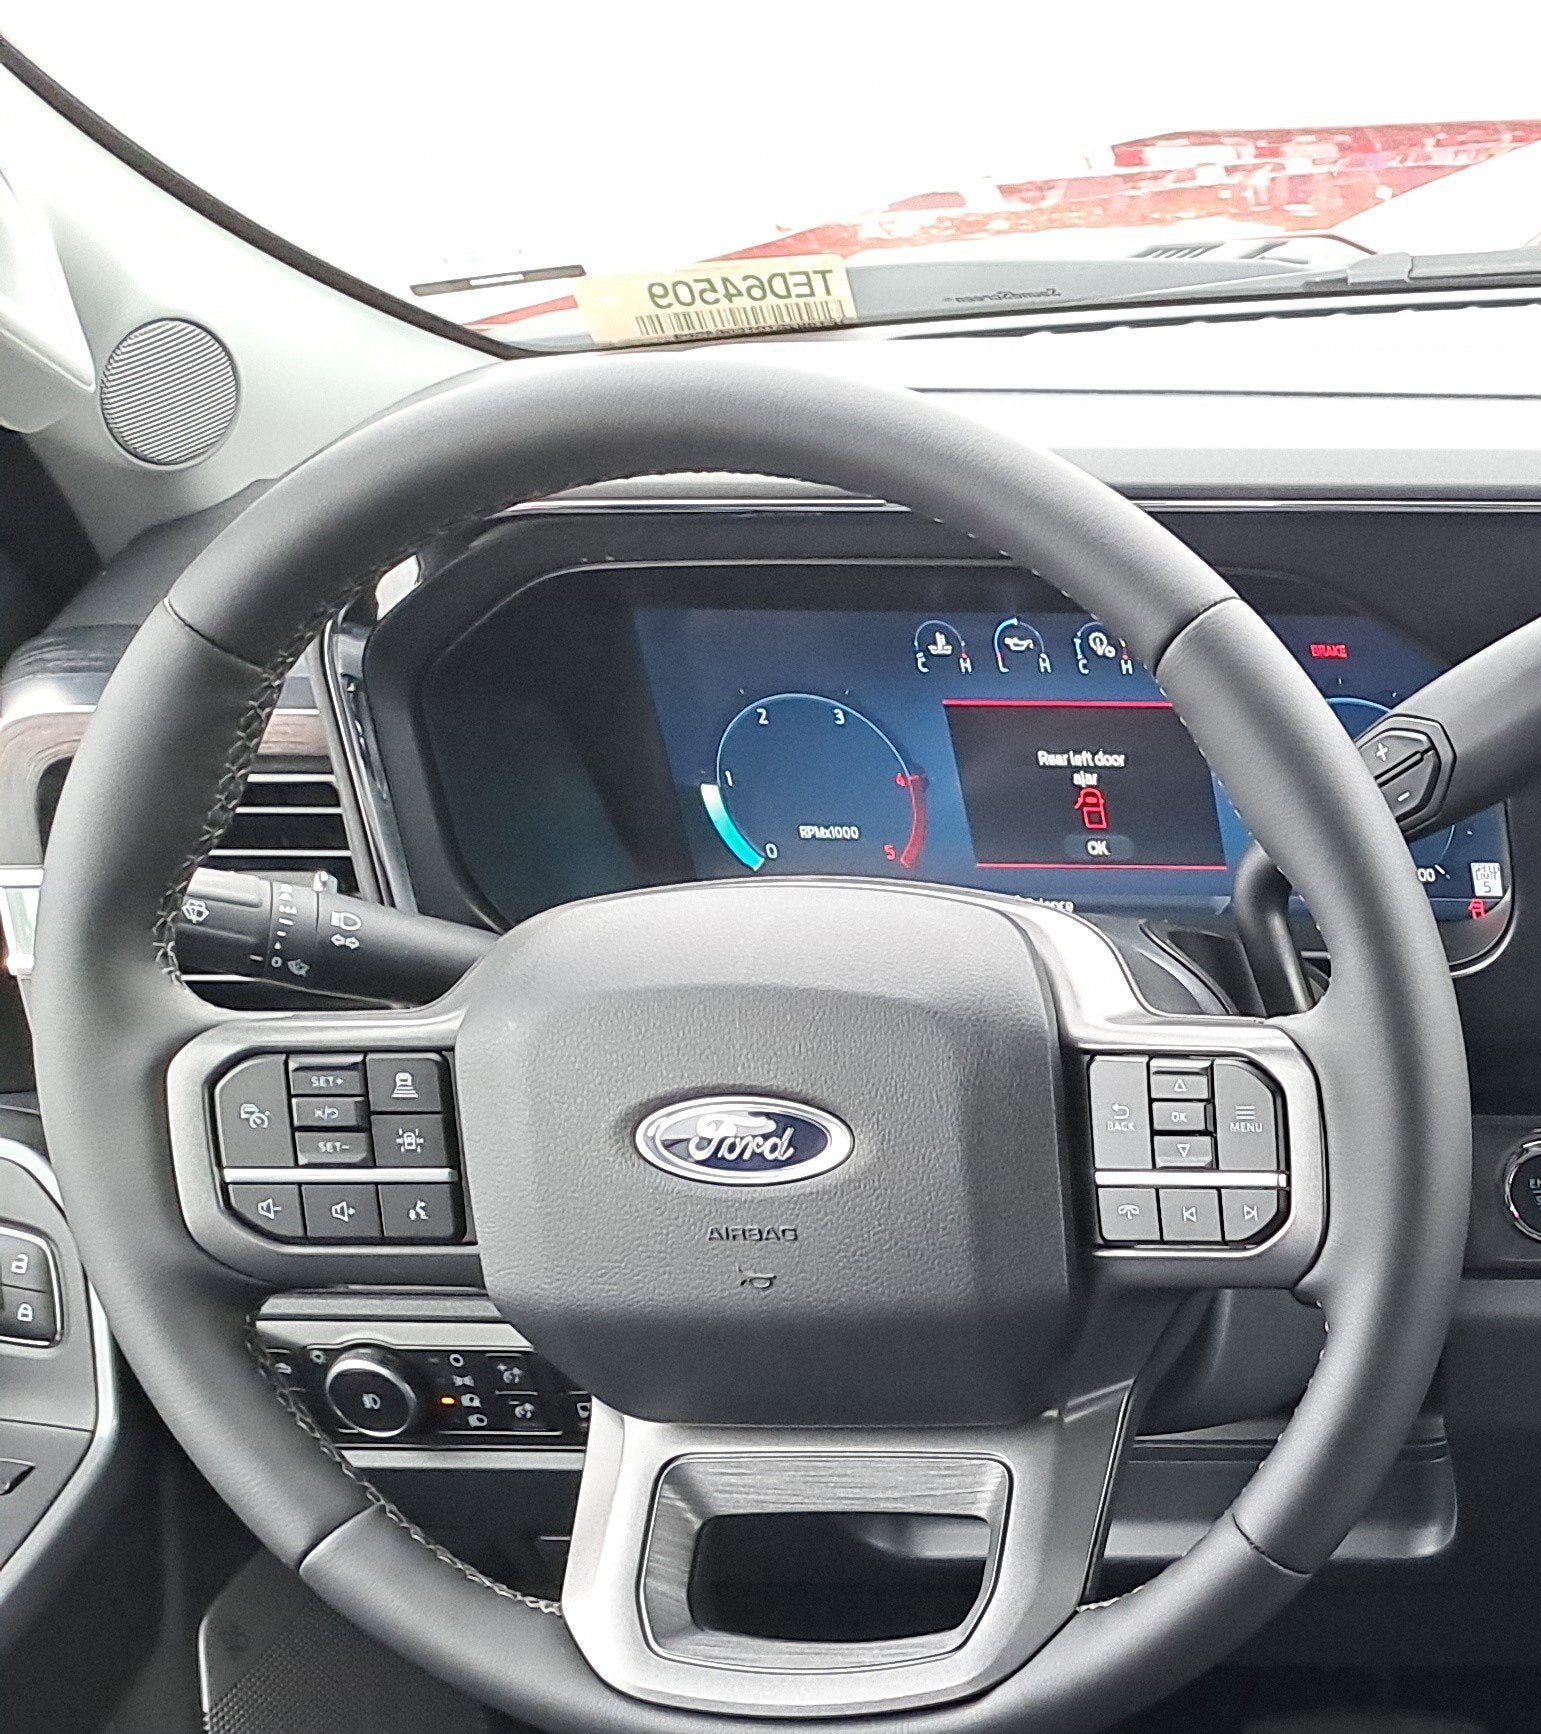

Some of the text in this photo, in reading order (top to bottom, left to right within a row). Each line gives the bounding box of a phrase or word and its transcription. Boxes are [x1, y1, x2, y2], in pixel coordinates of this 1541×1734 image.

[1309, 644, 1348, 658] BRAKE
[1121, 659, 1133, 674] H
[756, 708, 769, 724] 2
[833, 708, 845, 724] 3
[1037, 749, 1126, 767] Rear left door
[725, 770, 733, 787] 1
[1073, 771, 1098, 788] ajar
[765, 843, 778, 860] 0
[883, 844, 896, 861] 5
[1086, 840, 1109, 856] OK
[1484, 881, 1492, 894] 5
[310, 1076, 345, 1088] SET+
[1170, 1111, 1188, 1123] OK
[1107, 1121, 1136, 1132] BACK
[1229, 1122, 1263, 1133] MENU
[688, 1113, 796, 1163] Ford
[707, 1225, 799, 1242] AIRBAG
